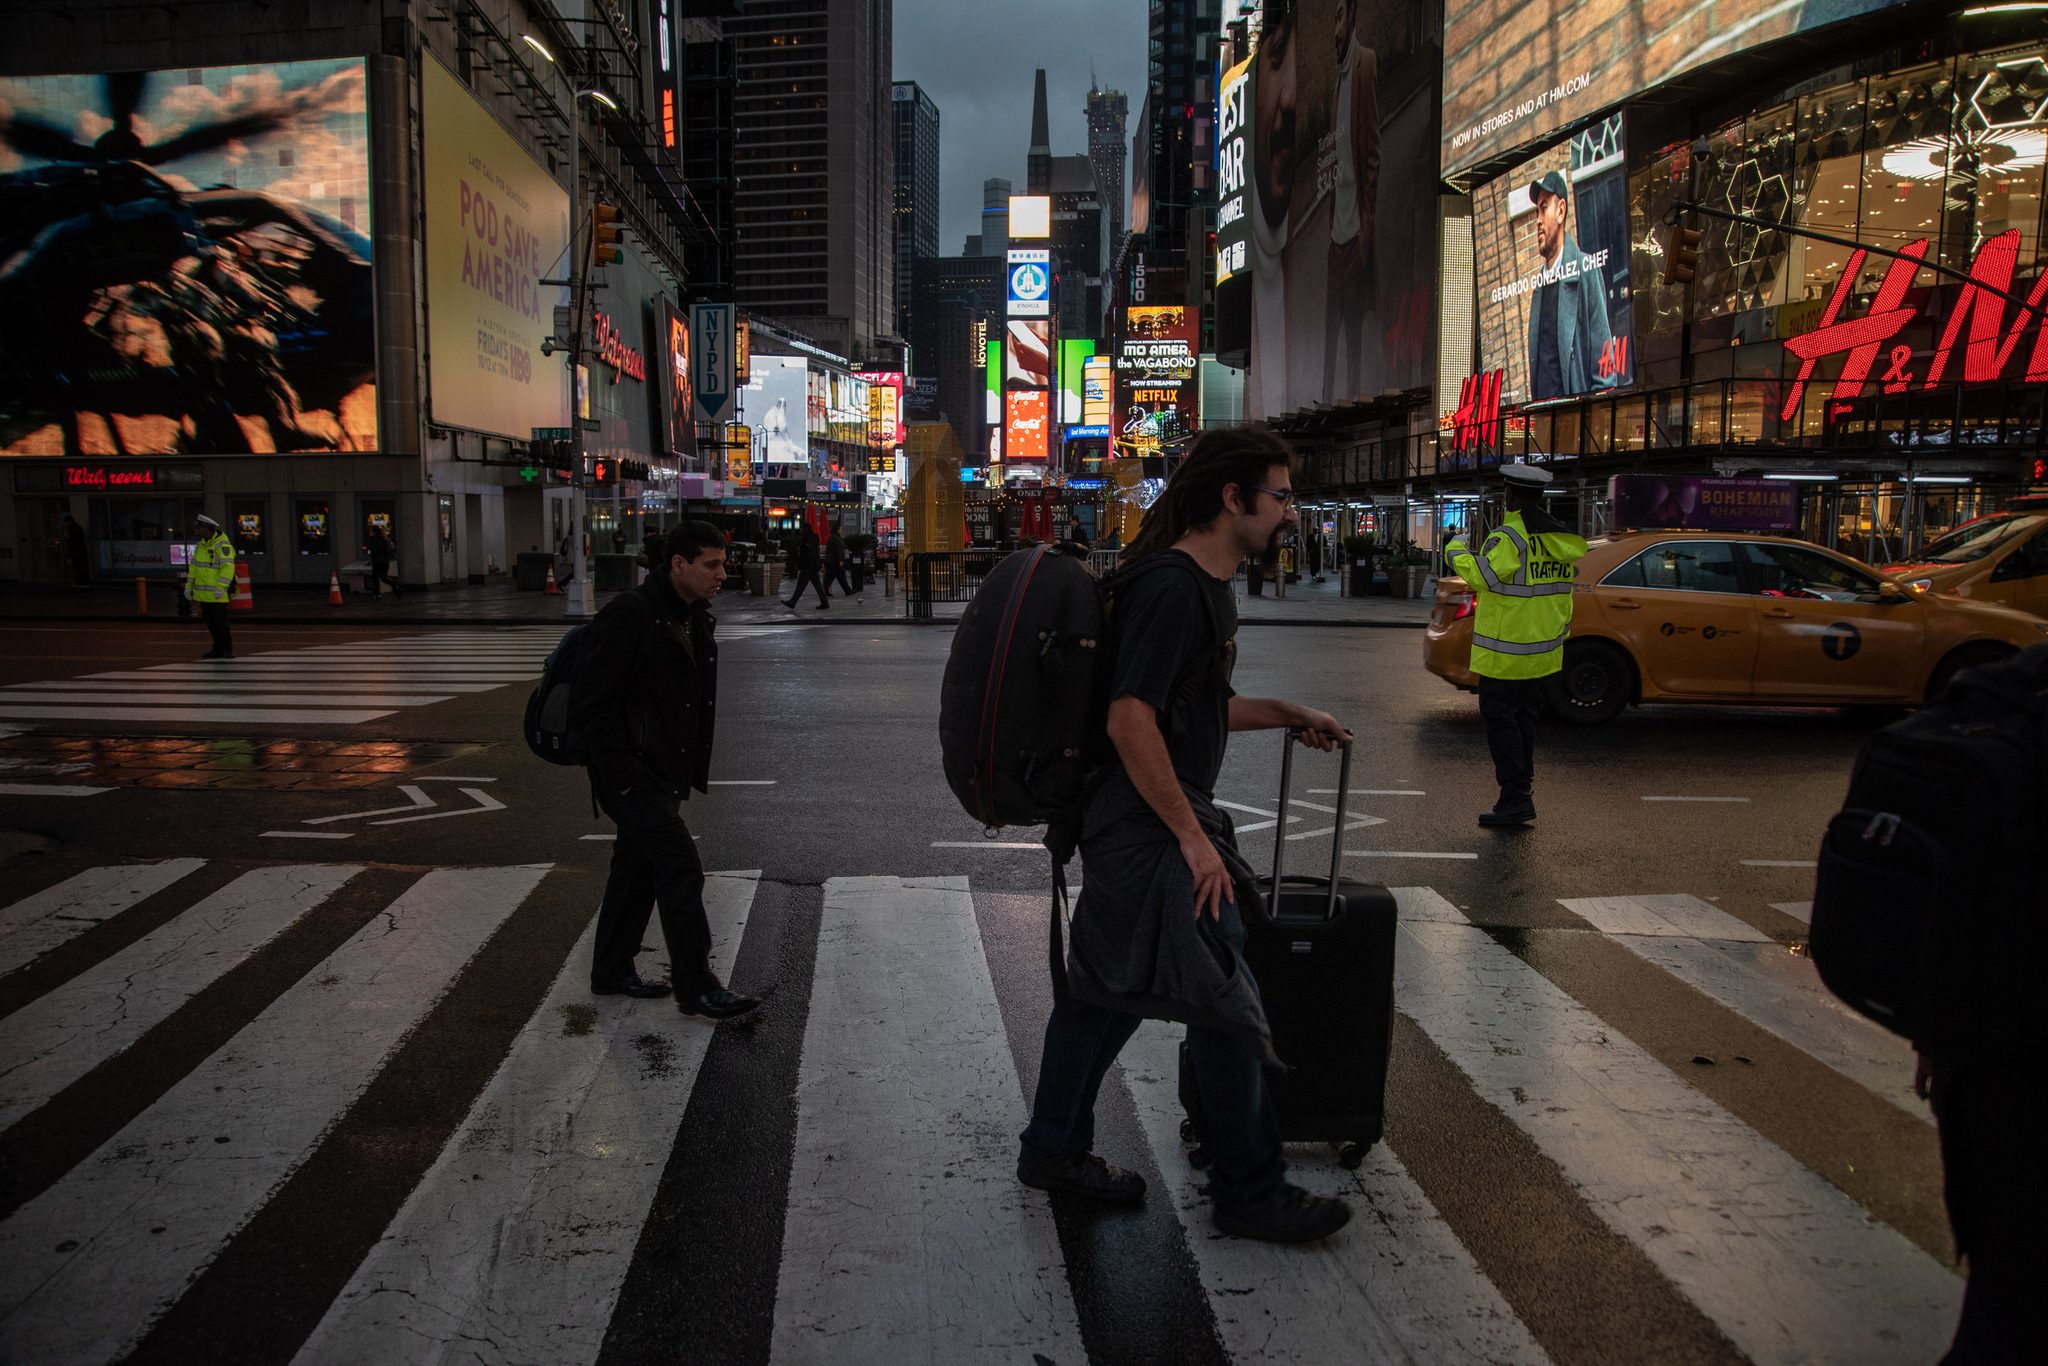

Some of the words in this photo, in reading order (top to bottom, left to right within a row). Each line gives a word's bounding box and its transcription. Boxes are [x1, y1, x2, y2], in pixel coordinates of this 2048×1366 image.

[1452, 127, 1472, 149] NOW
[1472, 124, 1481, 140] IN
[1481, 110, 1515, 135] STORES
[1515, 100, 1535, 120] AND
[1536, 91, 1549, 110] AT
[1549, 71, 1591, 104] HM.COM
[1219, 136, 1246, 201] BAR
[460, 179, 498, 247] POD
[504, 213, 540, 277] SAVE
[462, 238, 541, 324] AMERICA
[1135, 252, 1146, 302] 1500
[1491, 279, 1529, 304] GERARDO
[1530, 259, 1581, 291] GONZALEZ,
[1581, 248, 1609, 273] CHEF
[477, 329, 509, 361] FRIDAYS
[510, 344, 532, 385] HBO
[593, 312, 646, 385] Walgreens
[705, 310, 719, 393] NYPD
[977, 318, 987, 368] NOVOTEL
[1117, 356, 1132, 369] the
[1132, 357, 1197, 369] VAGABOND
[1134, 390, 1178, 403] NETFLIX
[1452, 367, 1503, 451] H&M
[541, 429, 548, 439] W
[551, 429, 561, 439] 42
[66, 466, 153, 490] Walgreens
[1701, 490, 1792, 506] BOHEMIAN
[1709, 505, 1783, 517] RHAPSODY
[1529, 560, 1571, 579] RAFFIC
